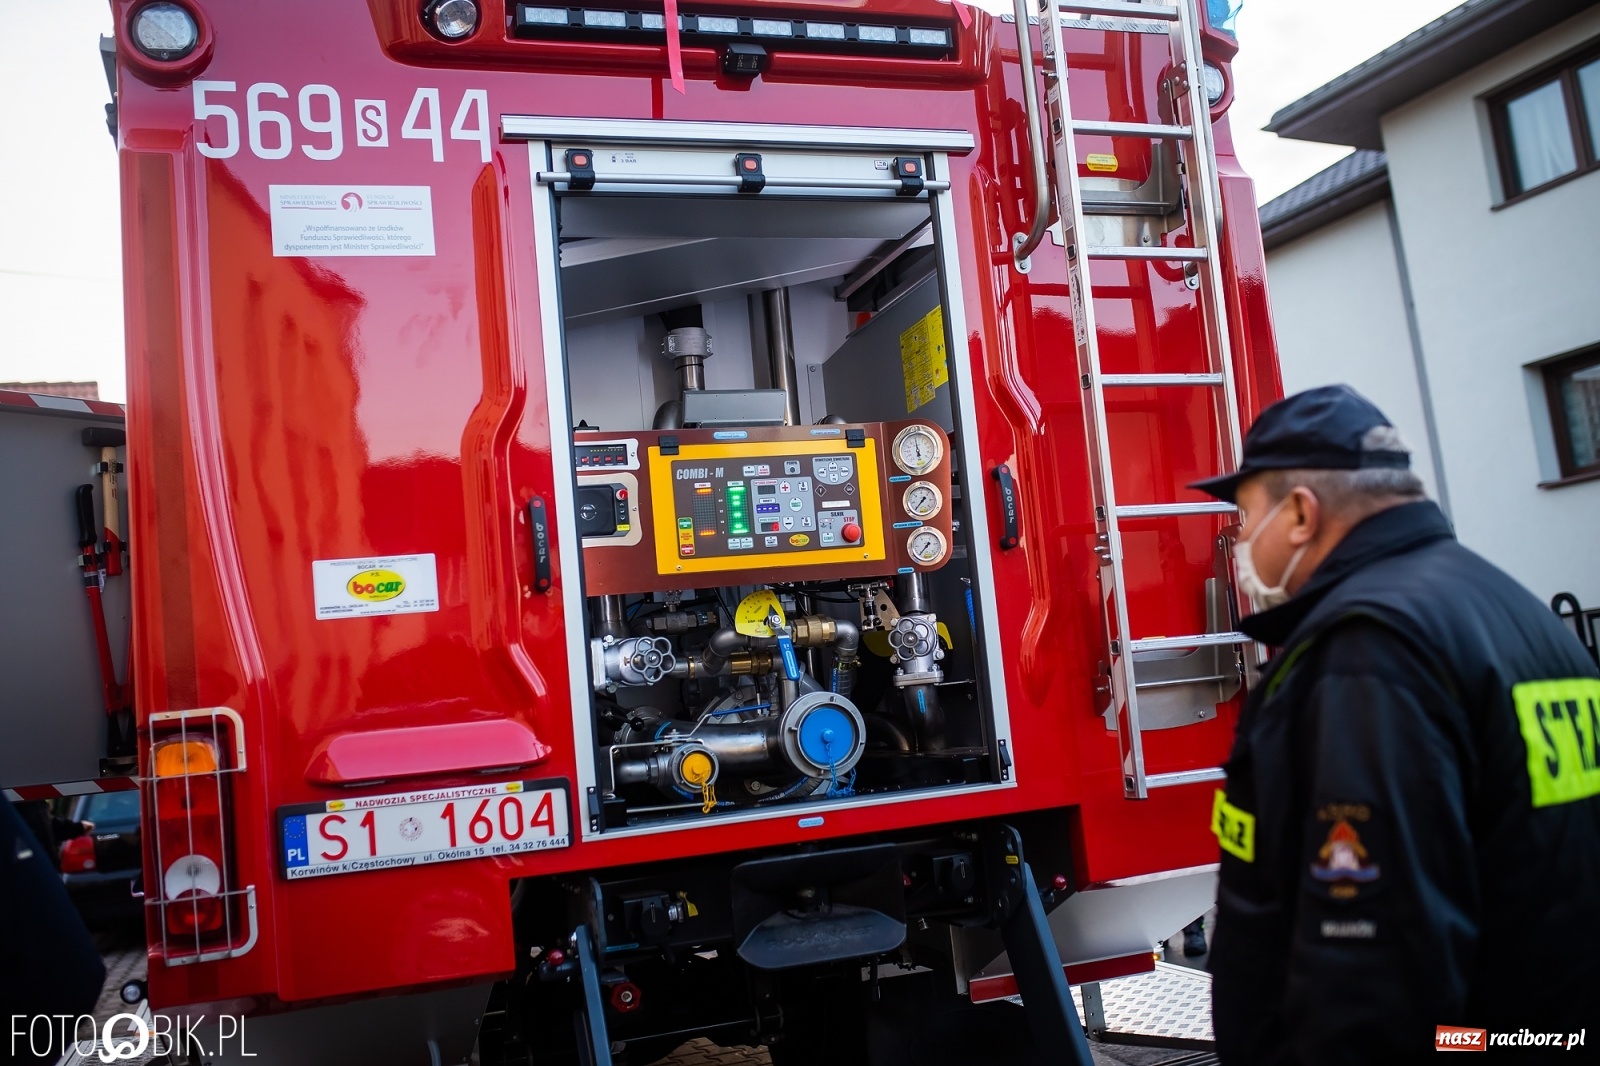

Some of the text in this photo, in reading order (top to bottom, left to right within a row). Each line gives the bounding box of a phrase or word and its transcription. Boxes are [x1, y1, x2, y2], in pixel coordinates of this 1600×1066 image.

[192, 80, 493, 163] 569 S 44
[376, 224, 404, 232] środków
[332, 234, 386, 242] Sprawiedliwości,
[387, 234, 412, 242] którego
[284, 243, 330, 252] dysponentem
[330, 243, 342, 251] jest
[676, 468, 708, 480] COMBI
[715, 467, 725, 478] M
[1004, 487, 1015, 524] bocar
[535, 522, 547, 564] bocar
[352, 581, 403, 595] bocar
[355, 796, 407, 809] NADWOZIA
[409, 787, 498, 803] SPECJALISTYCZNE
[319, 792, 556, 861] S1 1604
[287, 848, 306, 862] PL
[290, 863, 340, 877] Korwinów
[423, 853, 436, 862] ul.
[437, 849, 471, 861] Okólna
[474, 847, 485, 856] 15
[492, 844, 507, 853] tel.
[509, 842, 521, 852] 34
[522, 841, 535, 850] 32
[536, 839, 548, 848] 76
[549, 837, 566, 847] 444
